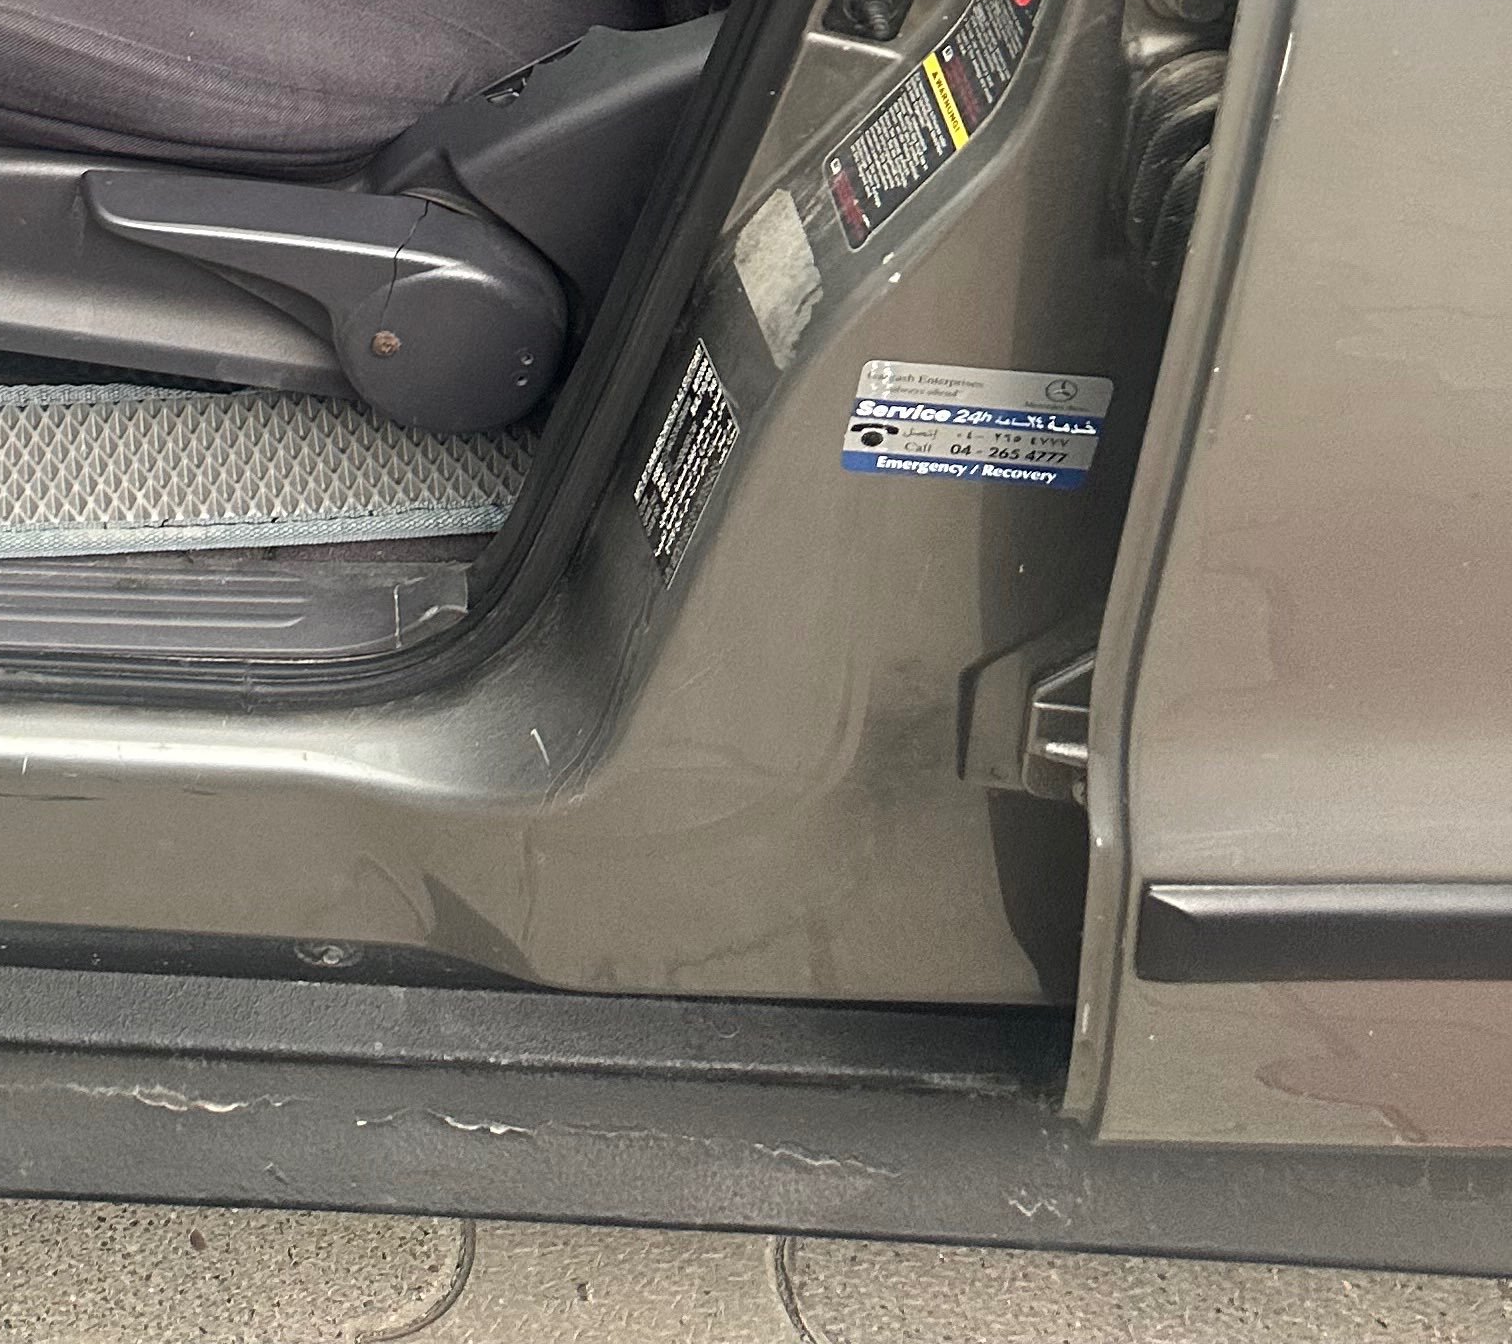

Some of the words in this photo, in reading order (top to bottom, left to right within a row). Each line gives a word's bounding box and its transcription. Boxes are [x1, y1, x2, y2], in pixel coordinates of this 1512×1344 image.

[855, 400, 952, 422] Service
[953, 409, 992, 425] 24h
[1047, 415, 1097, 434] خدمة
[904, 441, 932, 453] Call
[950, 444, 972, 456] 04
[988, 447, 1020, 460] 265
[1025, 450, 1068, 464] 4777
[876, 456, 968, 477] Emergency
[970, 464, 979, 475] /
[981, 464, 1057, 484] Recovery
